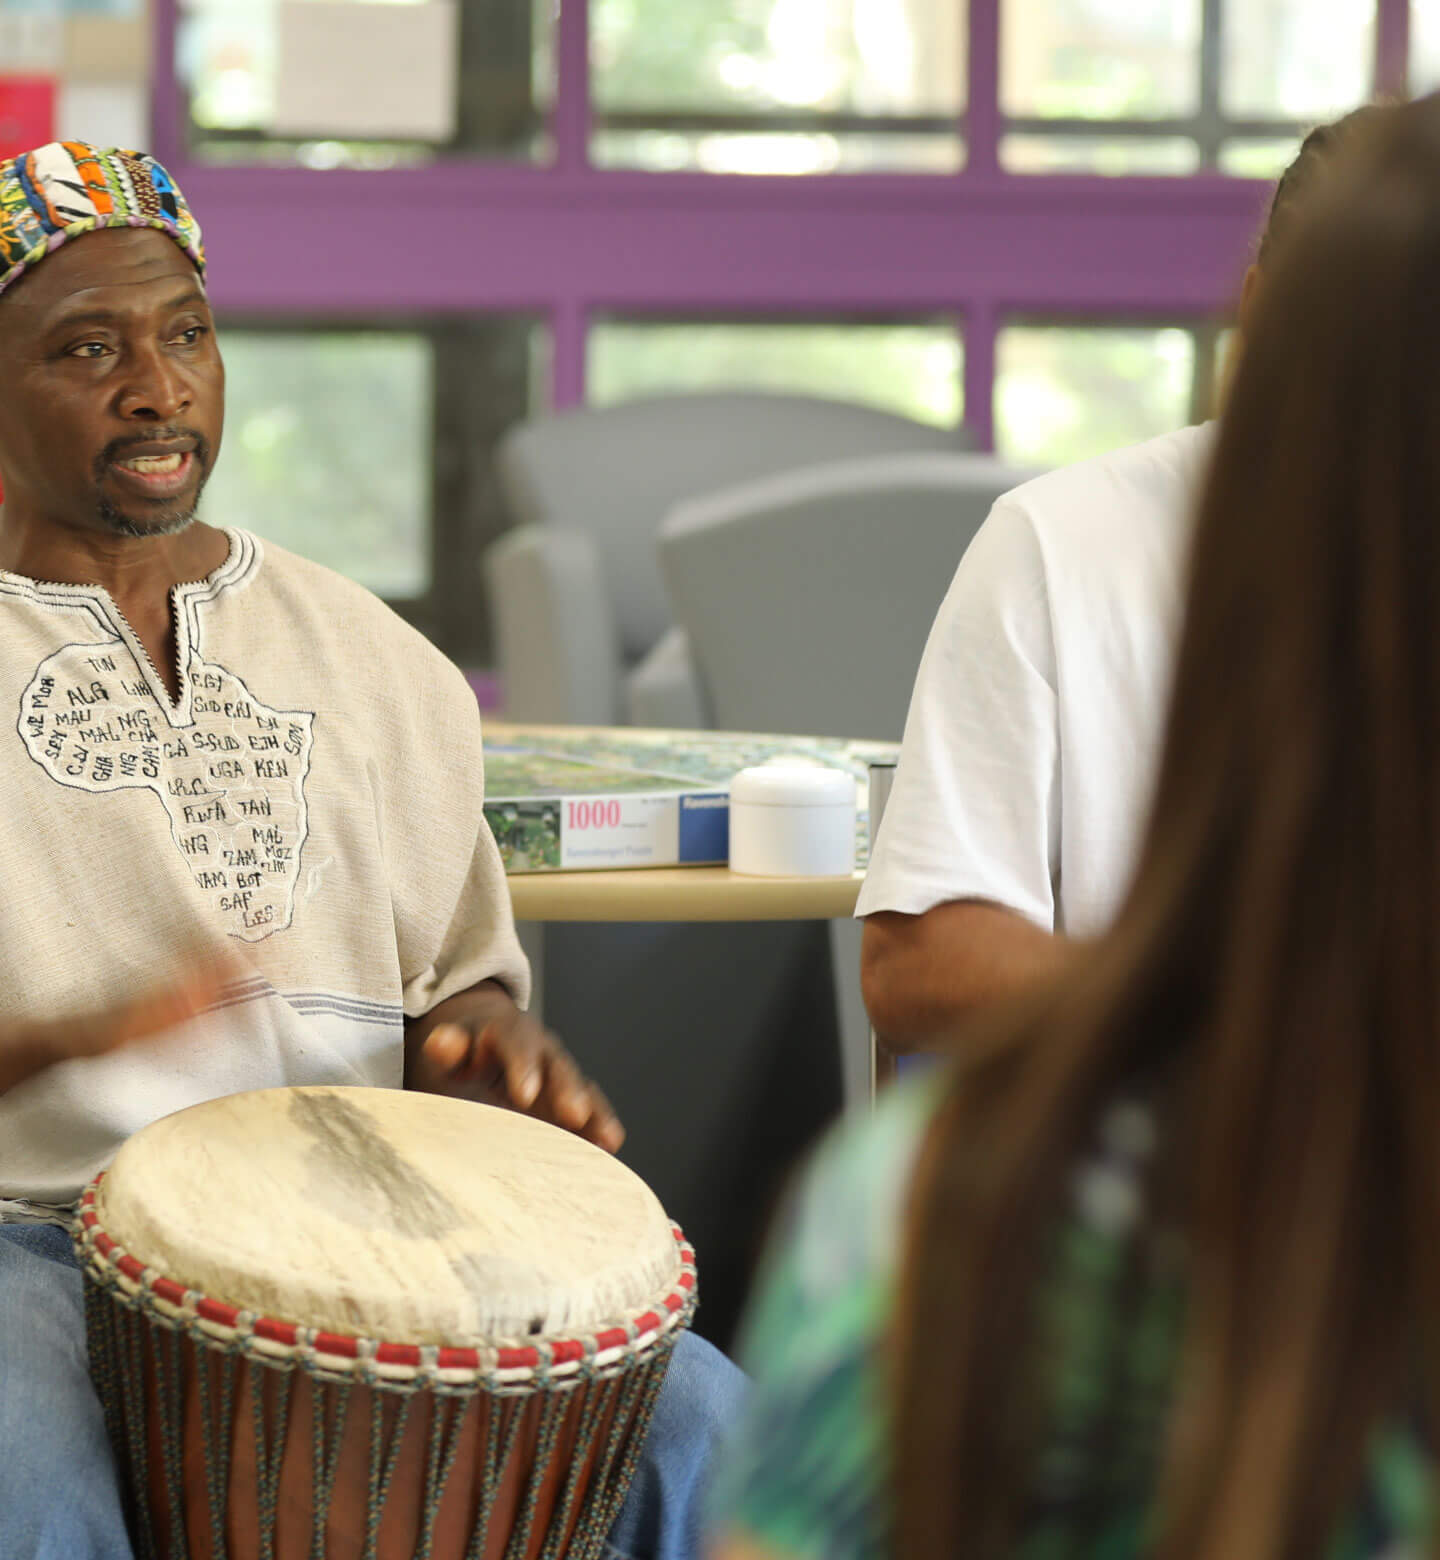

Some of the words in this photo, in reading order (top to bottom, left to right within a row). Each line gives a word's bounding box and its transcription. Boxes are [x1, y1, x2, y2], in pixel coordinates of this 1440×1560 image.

[67, 681, 109, 706] ALG
[55, 709, 91, 726] MAU
[79, 722, 120, 743] MAL
[92, 756, 113, 781] GHA
[210, 761, 244, 778] UGA
[255, 759, 288, 778] KEN
[238, 797, 271, 816] TAN
[567, 800, 621, 830] 1000
